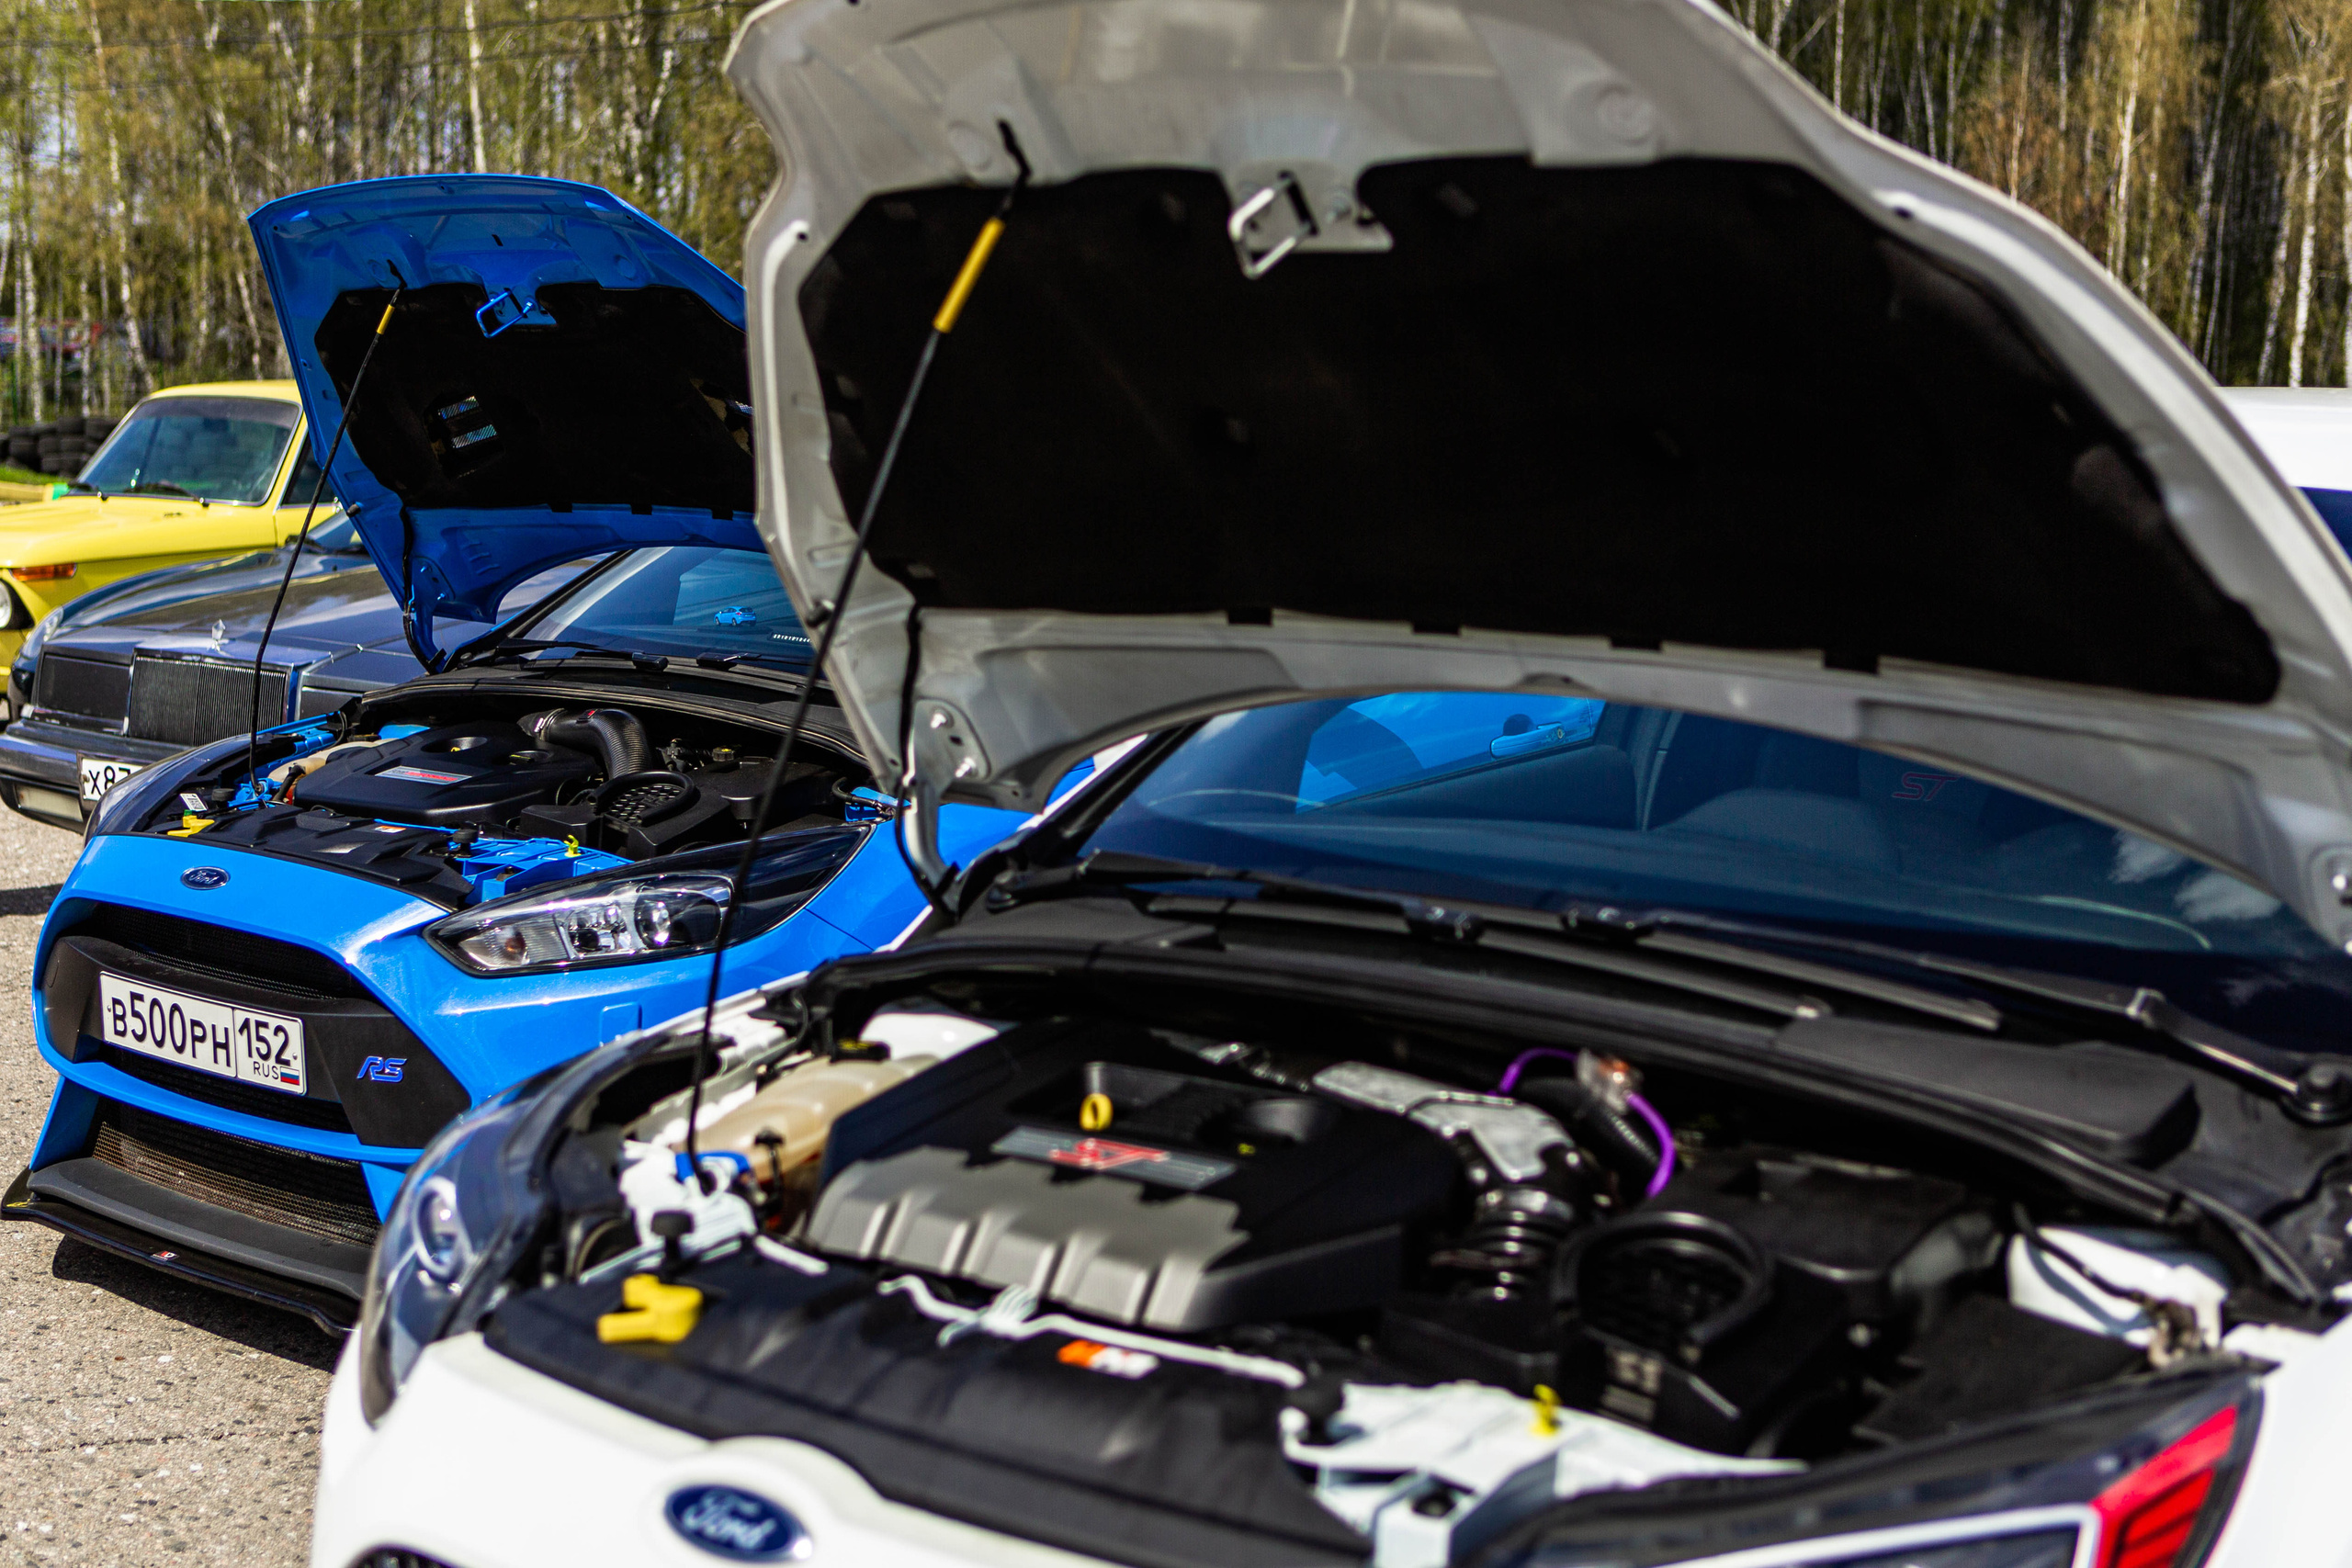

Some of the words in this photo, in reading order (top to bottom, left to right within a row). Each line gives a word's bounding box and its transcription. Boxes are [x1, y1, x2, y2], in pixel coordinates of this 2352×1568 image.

[1891, 773, 1961, 801] ST
[188, 870, 220, 885] Ford
[111, 990, 232, 1067] B500PH
[238, 1017, 291, 1067] 152
[253, 1060, 280, 1080] RUS
[356, 1055, 408, 1083] RS
[683, 1490, 777, 1550] Ford
